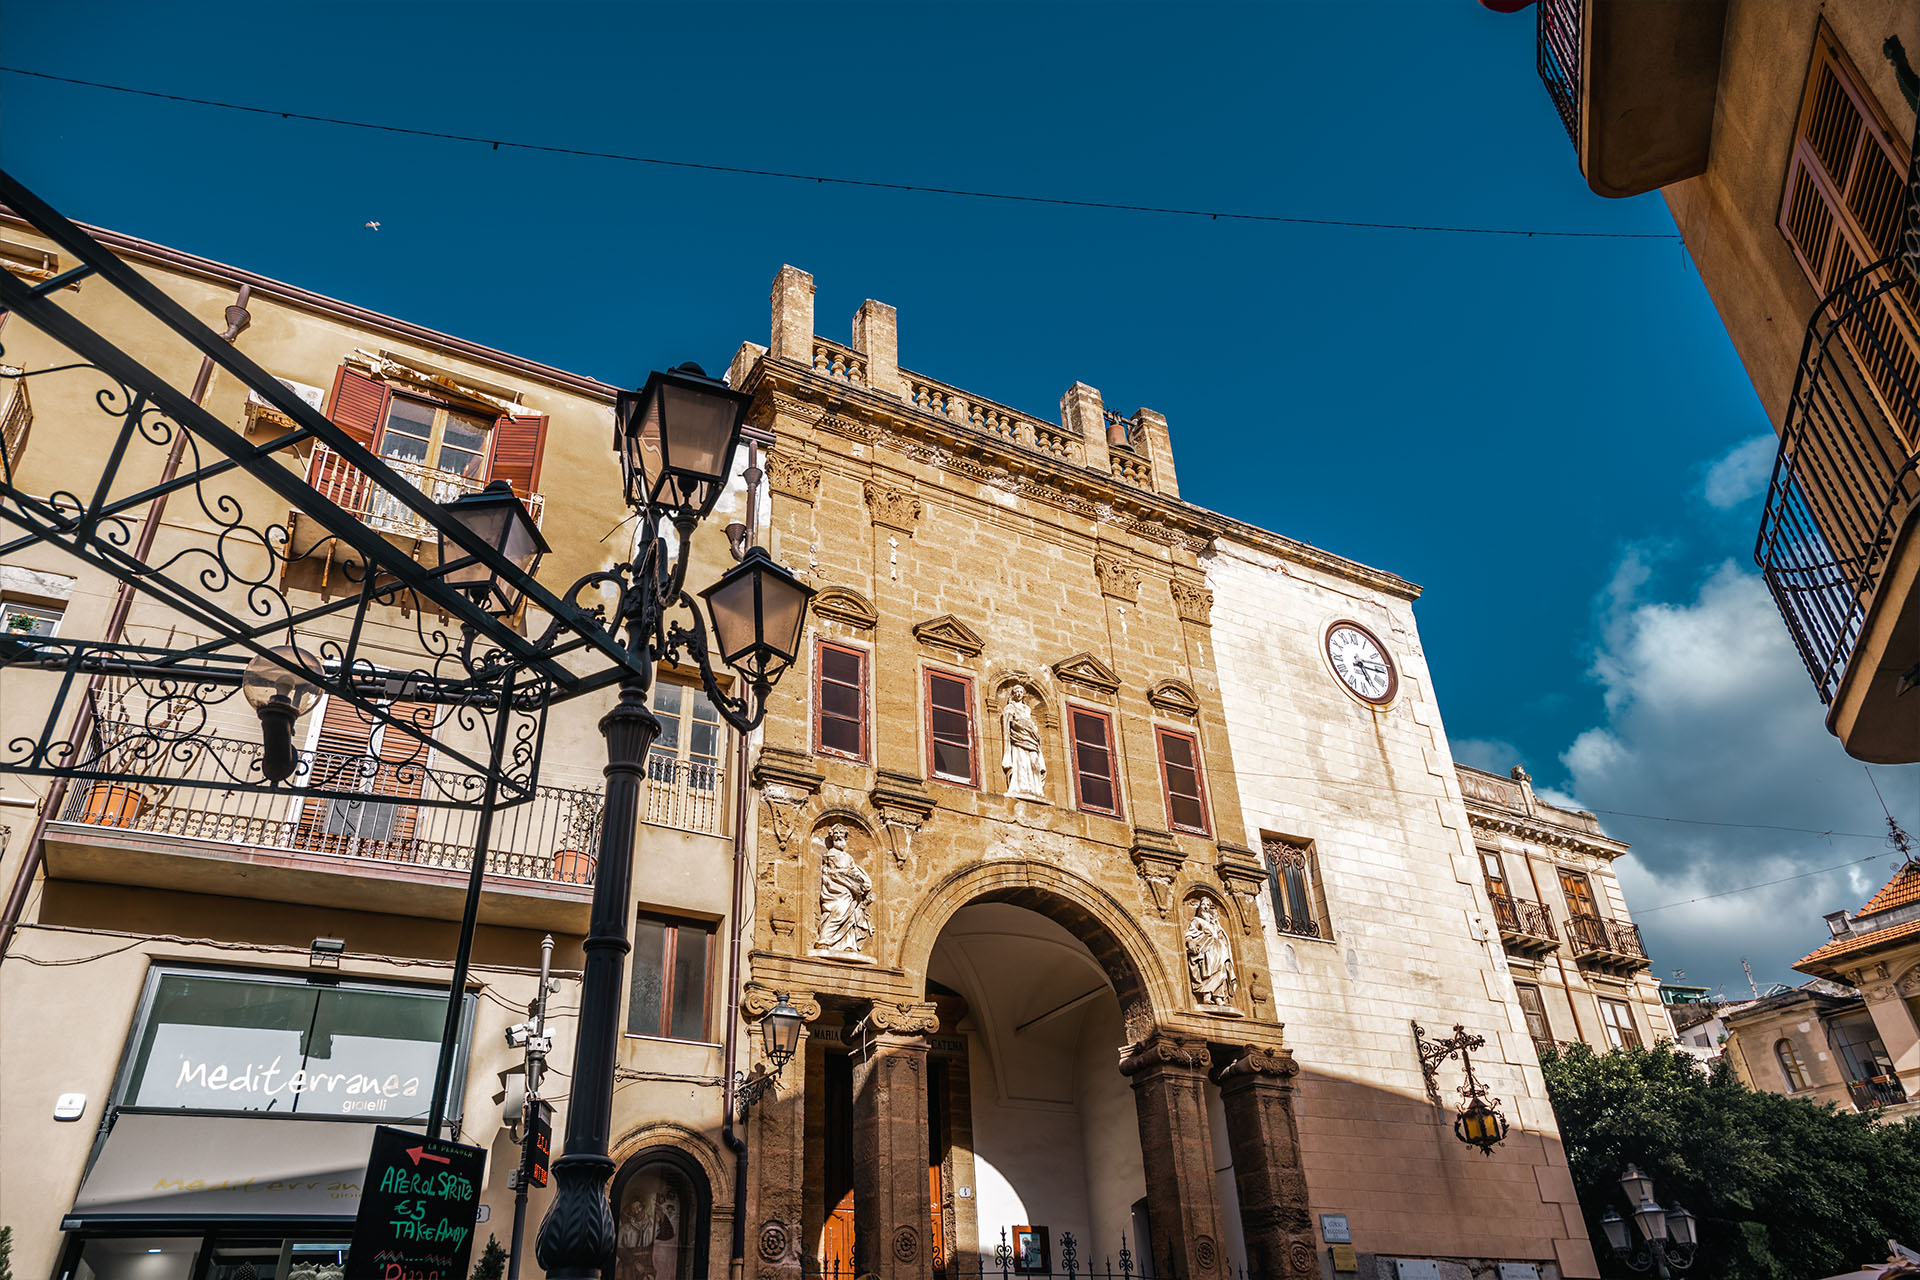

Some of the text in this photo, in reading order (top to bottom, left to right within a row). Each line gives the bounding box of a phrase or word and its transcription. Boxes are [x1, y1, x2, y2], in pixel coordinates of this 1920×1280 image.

[814, 1029, 839, 1041] MARIA
[176, 1056, 420, 1097] Mediterranea
[342, 1099, 388, 1113] gioielli
[379, 1165, 436, 1196] APEROL
